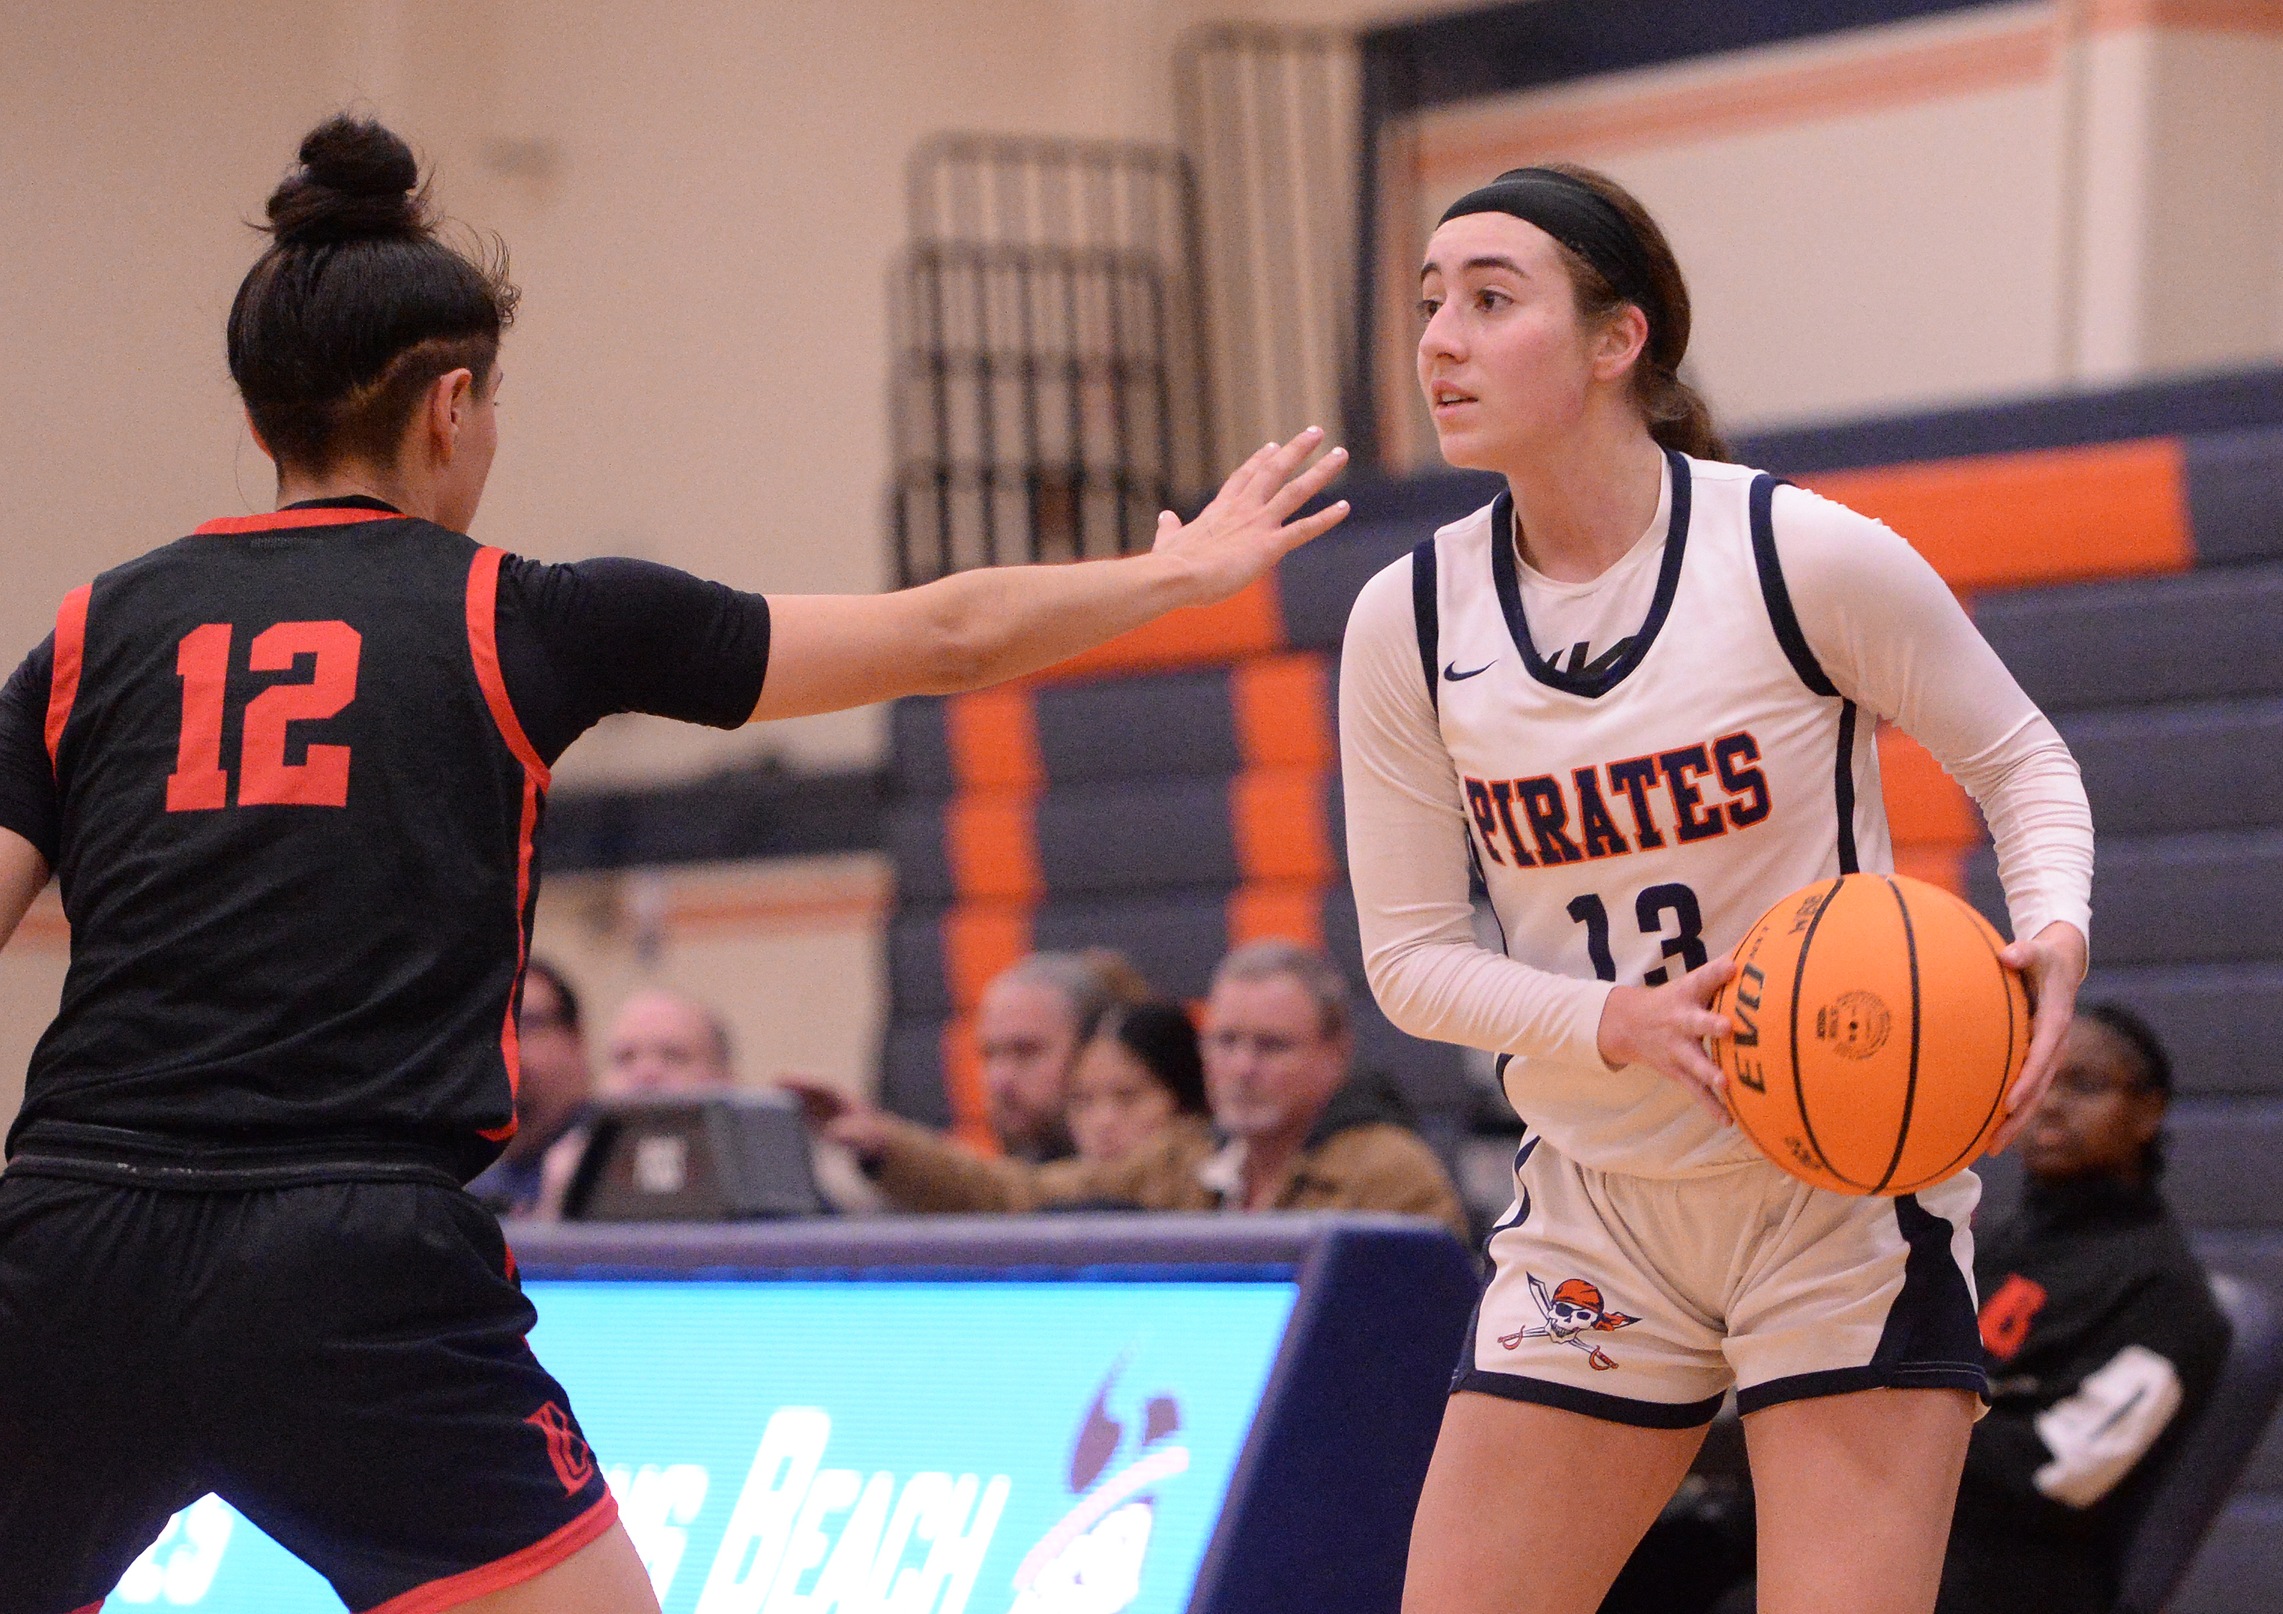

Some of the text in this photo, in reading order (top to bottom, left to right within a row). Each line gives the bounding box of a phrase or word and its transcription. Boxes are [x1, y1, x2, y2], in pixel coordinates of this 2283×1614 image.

[166, 620, 362, 812] 12
[1464, 730, 1772, 870] PIRATES
[1565, 882, 1709, 987] 13
[1731, 962, 1768, 1096] EVO
